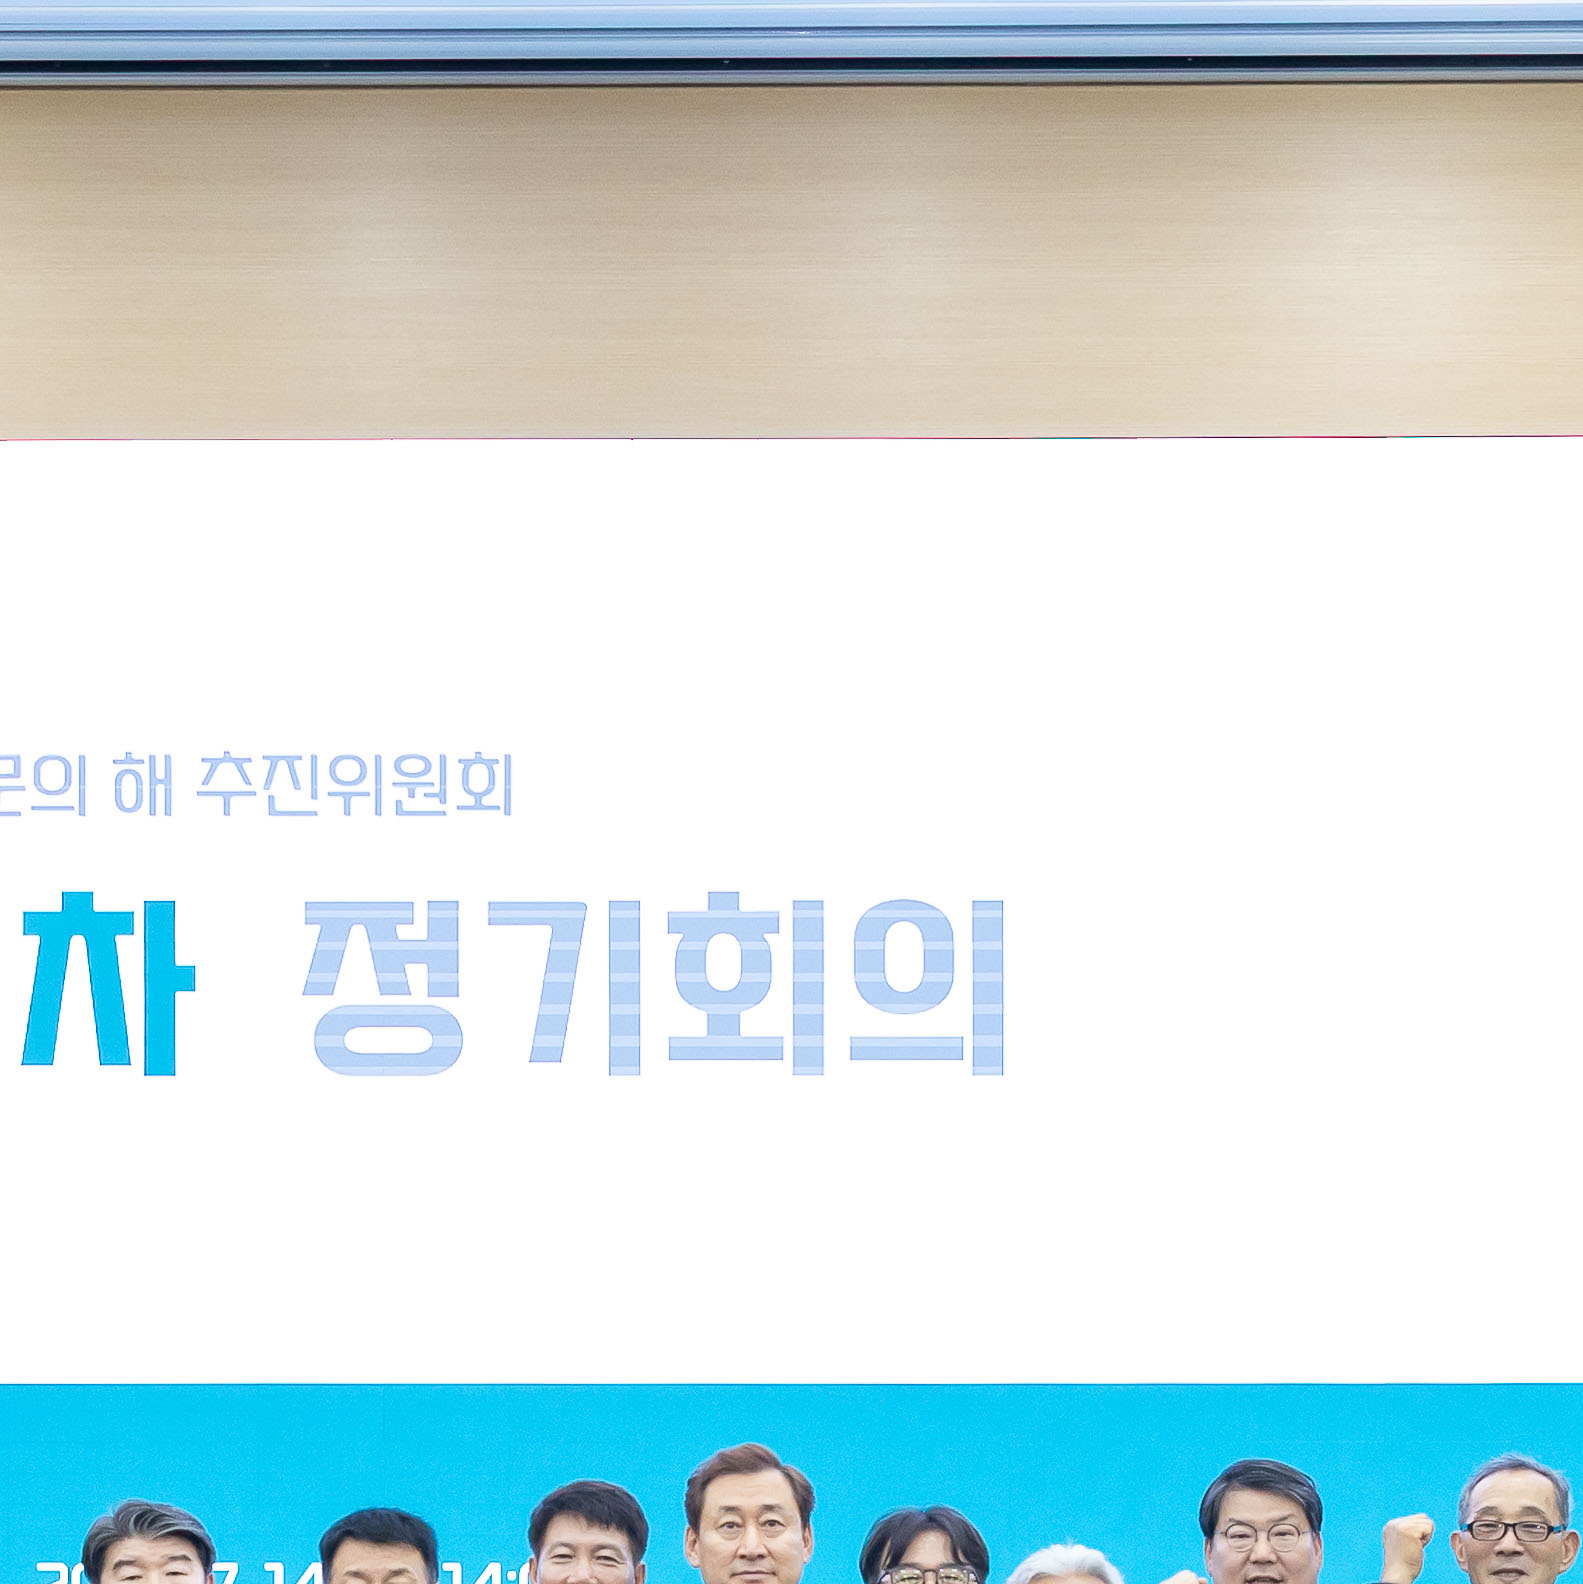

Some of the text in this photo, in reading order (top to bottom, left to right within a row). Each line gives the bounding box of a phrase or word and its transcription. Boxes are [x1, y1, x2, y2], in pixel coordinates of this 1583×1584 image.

[112, 751, 172, 817] 해
[196, 751, 512, 817] 추진위원회
[302, 890, 1004, 1077] 정기회의
